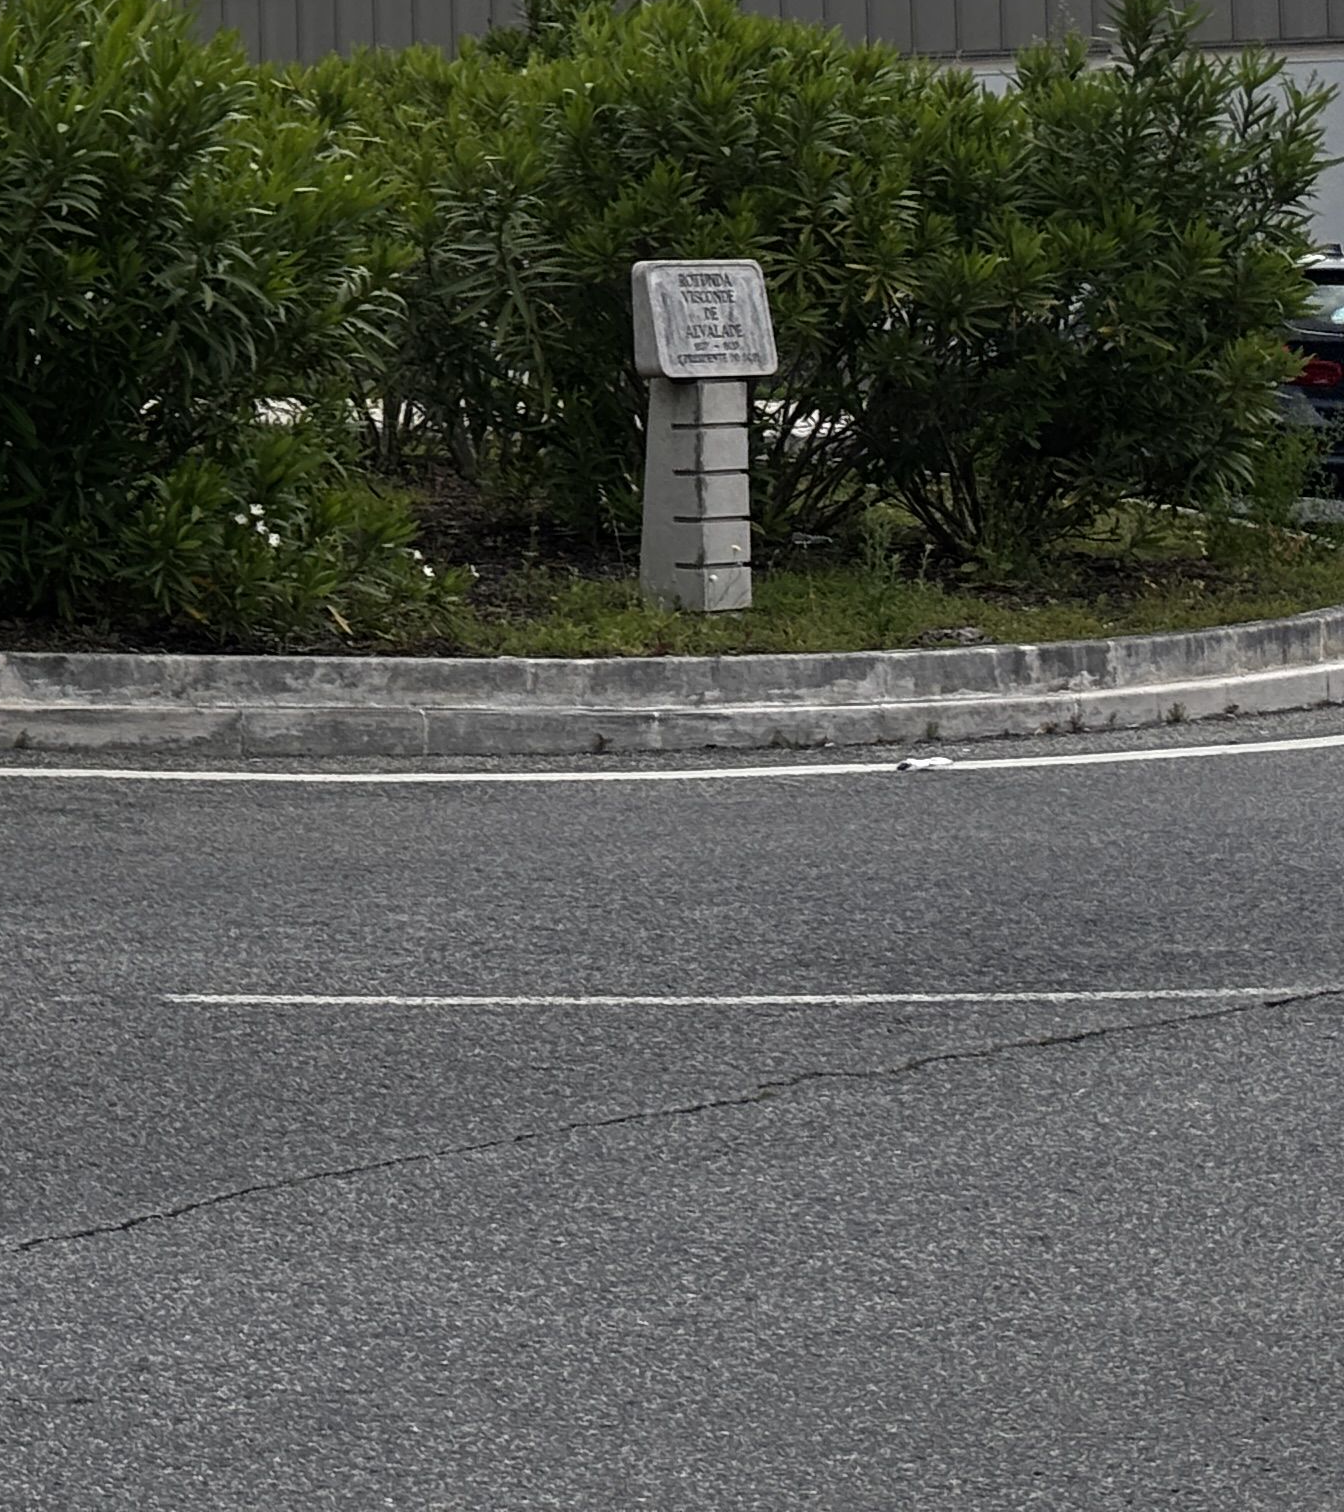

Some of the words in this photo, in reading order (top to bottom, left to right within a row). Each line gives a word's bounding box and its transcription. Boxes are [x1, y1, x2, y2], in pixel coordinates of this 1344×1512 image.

[678, 273, 733, 288] ROTUNDA
[680, 290, 736, 304] VISCONDE
[704, 306, 720, 321] DE
[685, 324, 744, 339] ALVALADE
